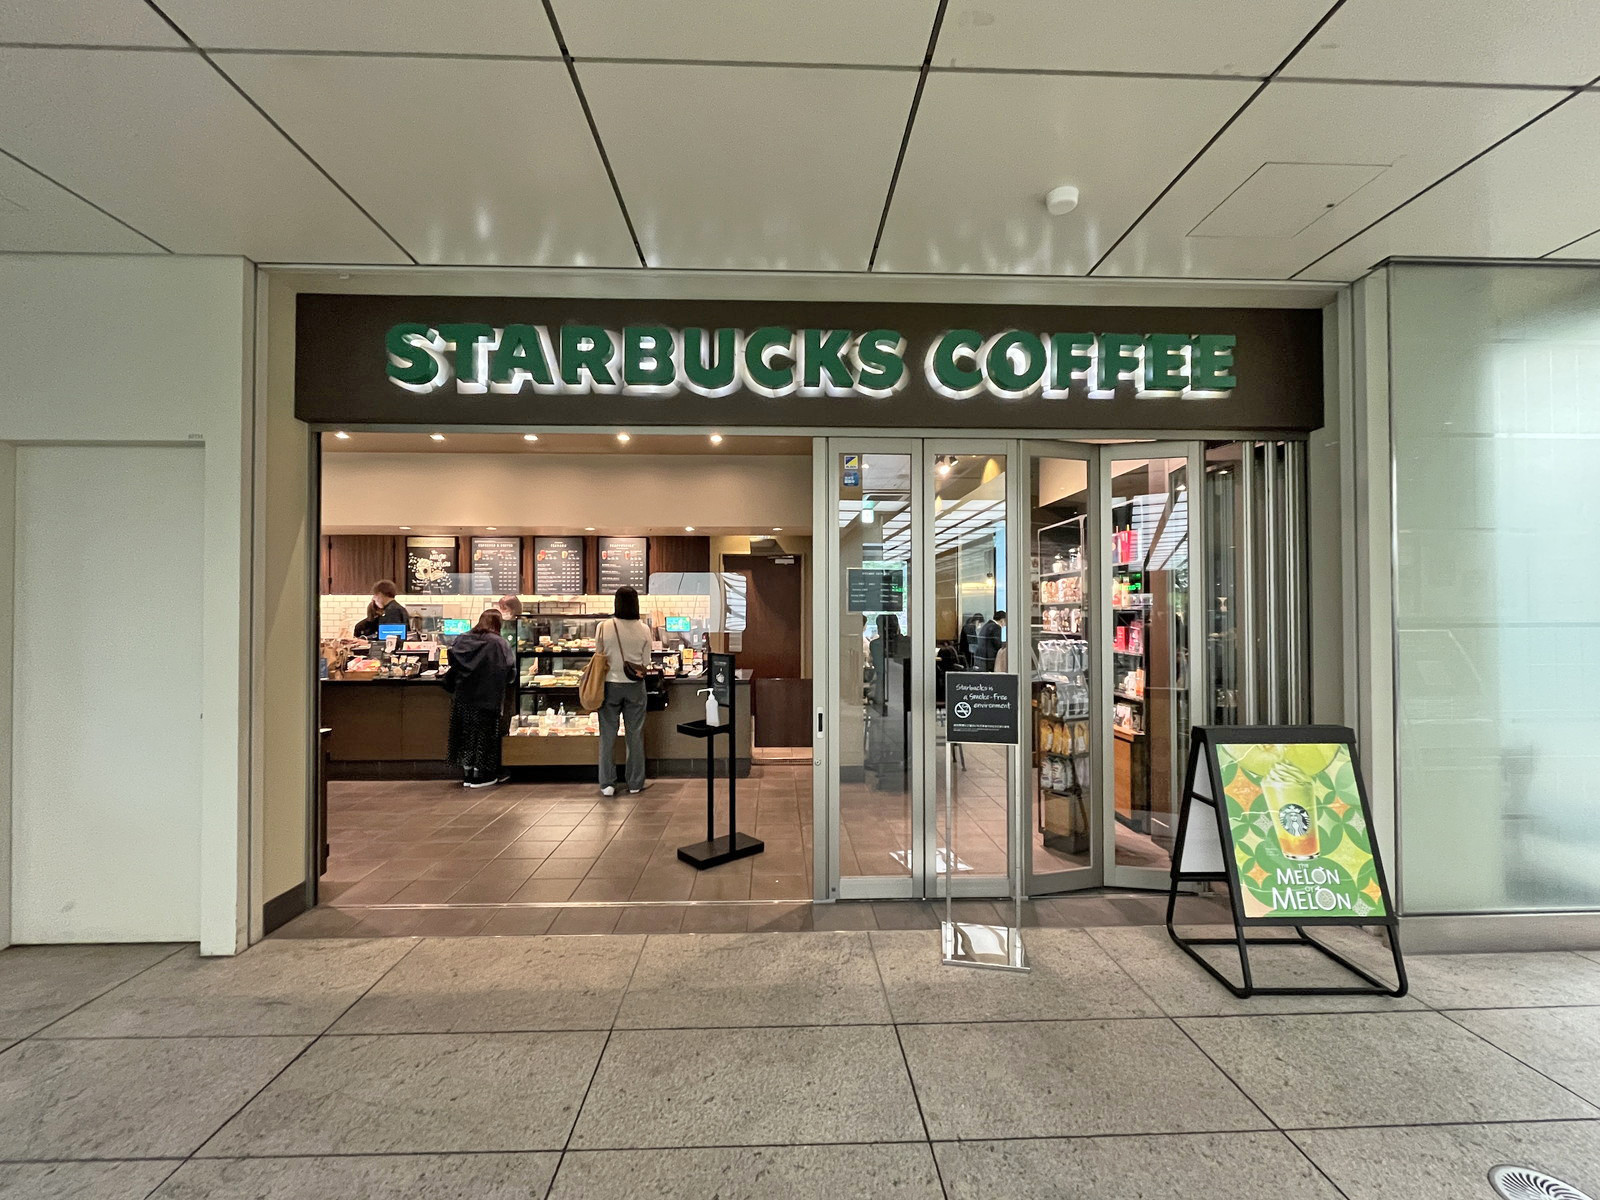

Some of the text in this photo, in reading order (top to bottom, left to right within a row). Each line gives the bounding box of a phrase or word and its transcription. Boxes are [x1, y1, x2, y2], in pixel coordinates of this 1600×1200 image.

[385, 323, 1238, 400] STARBUCKS COFFEE
[955, 684, 988, 692] Starbucks
[973, 702, 1011, 710] environment
[1276, 866, 1341, 885] MELON
[1271, 886, 1352, 911] MELON
